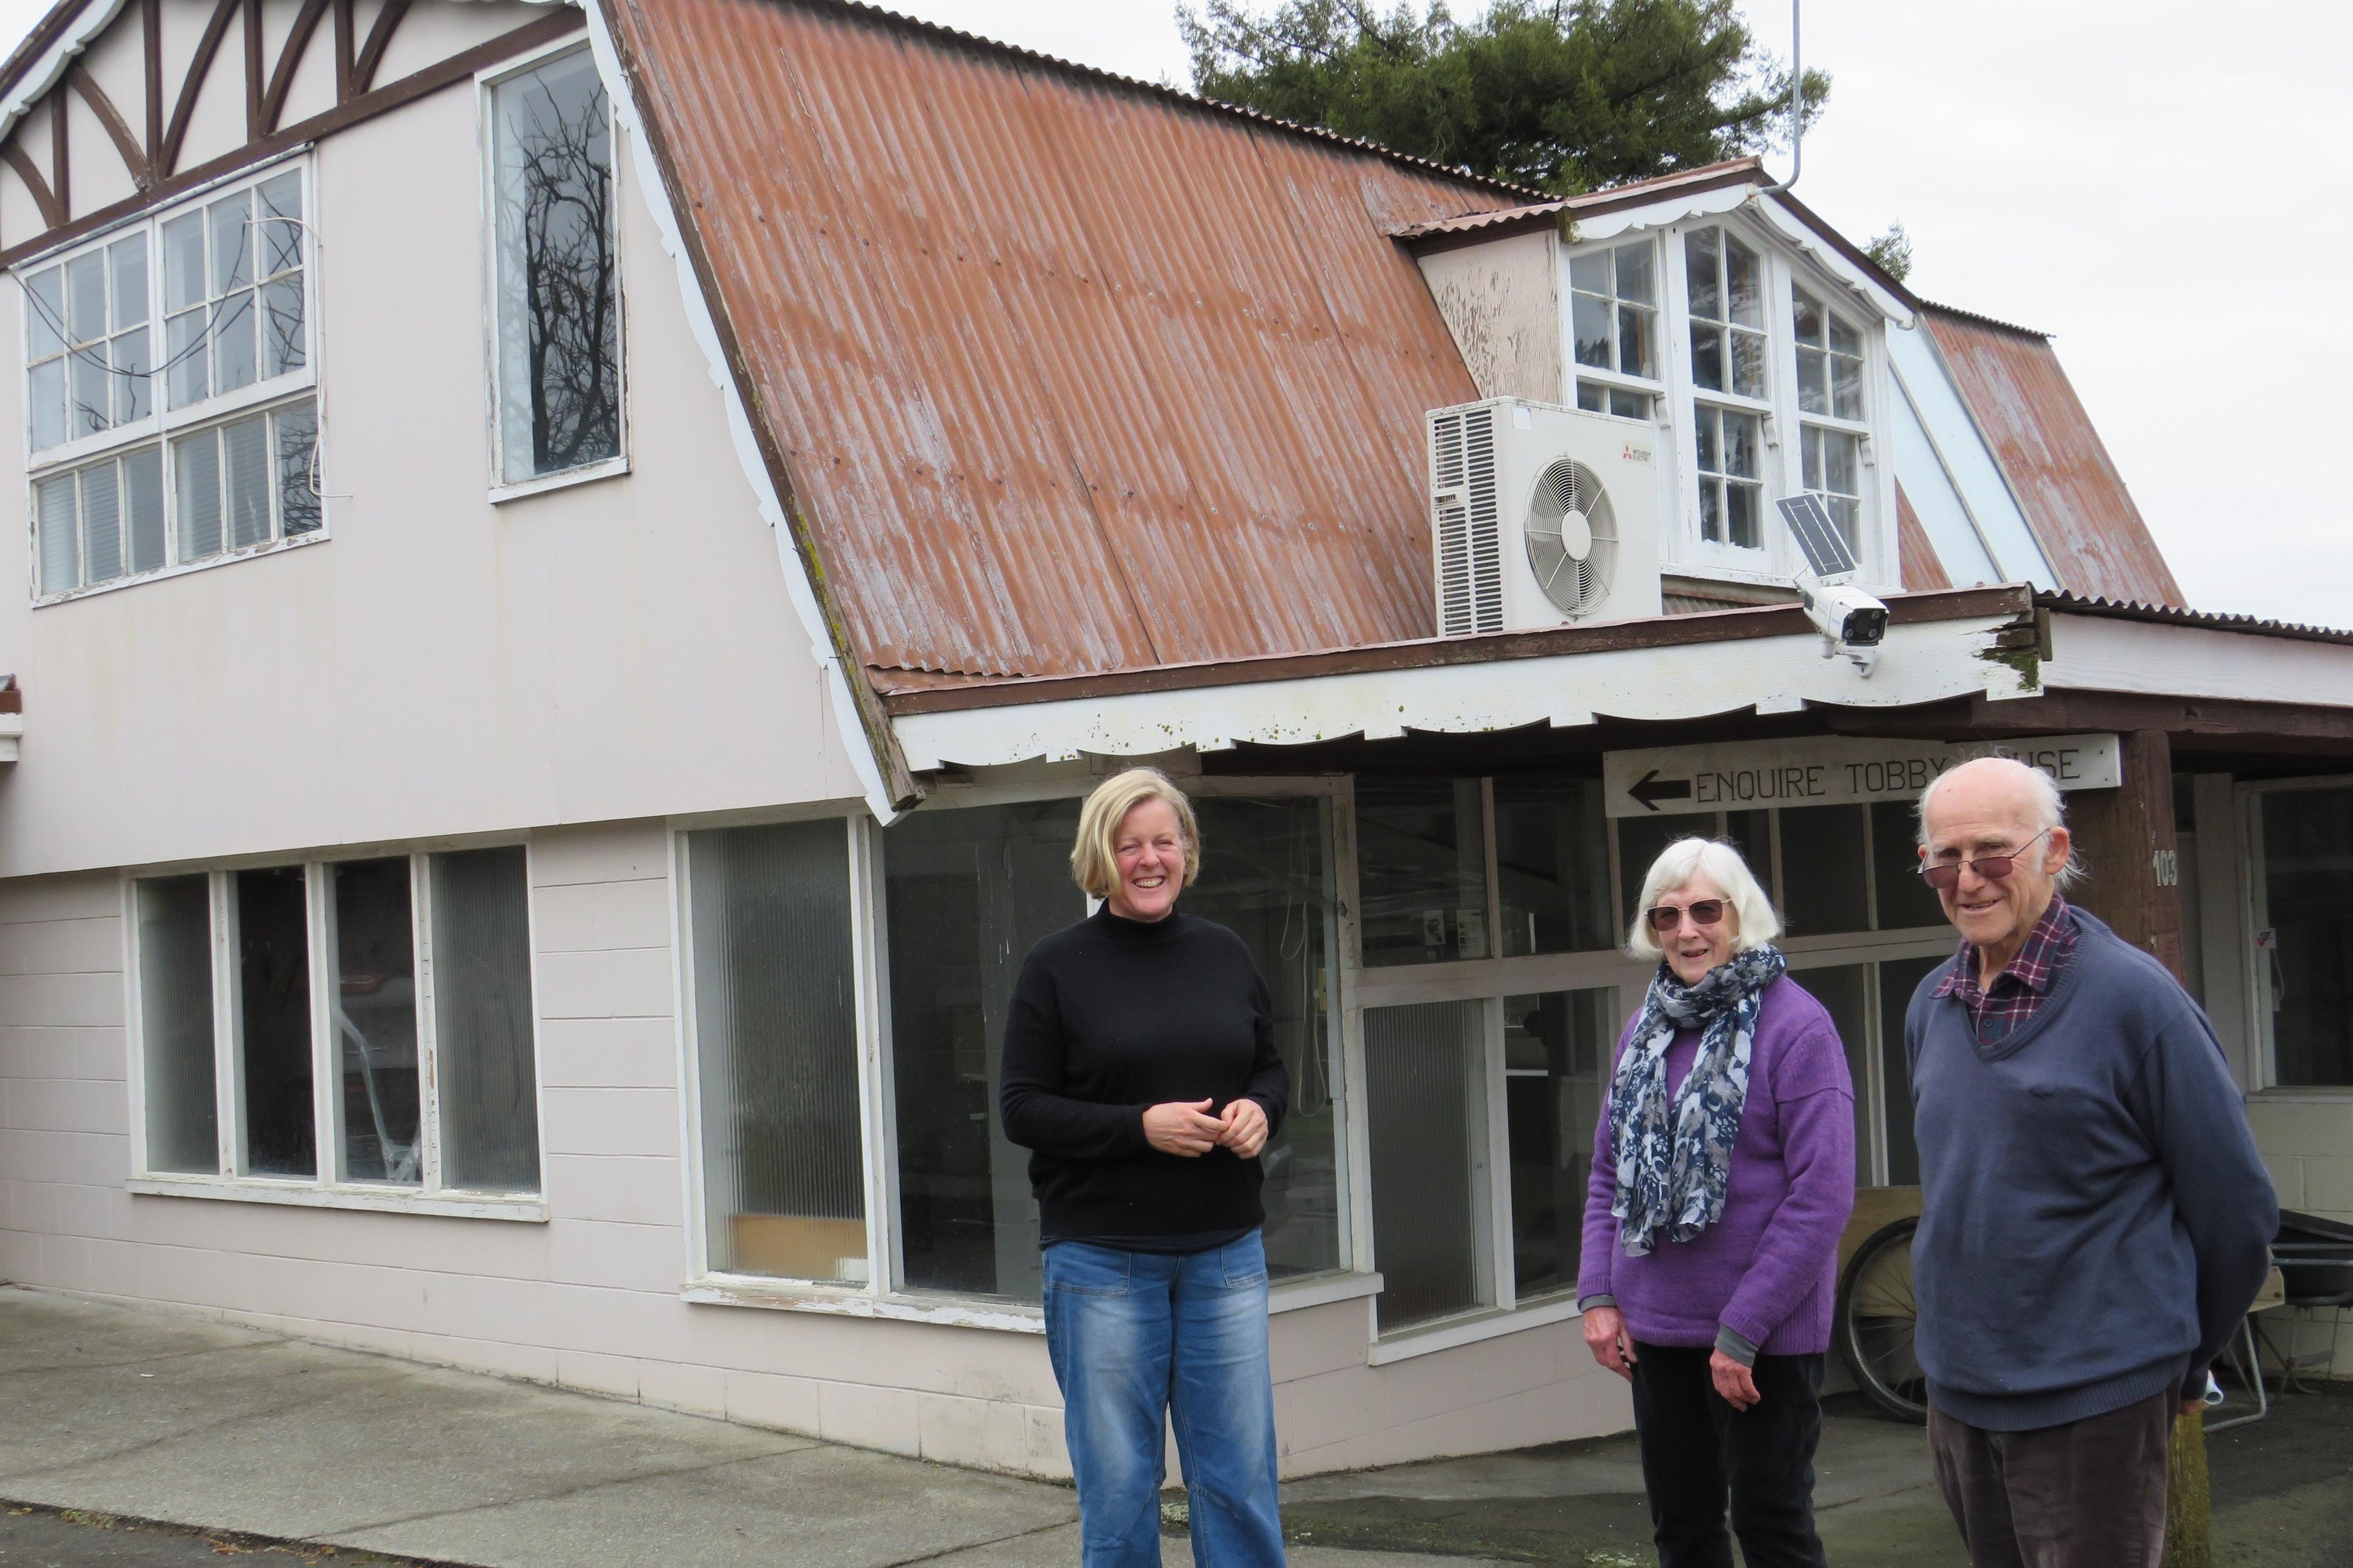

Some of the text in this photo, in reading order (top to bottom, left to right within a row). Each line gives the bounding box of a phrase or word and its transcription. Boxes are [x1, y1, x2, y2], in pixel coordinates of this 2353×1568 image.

[1696, 757, 1948, 803] ENQUIRE TOBBY
[2153, 850, 2177, 886] 103
